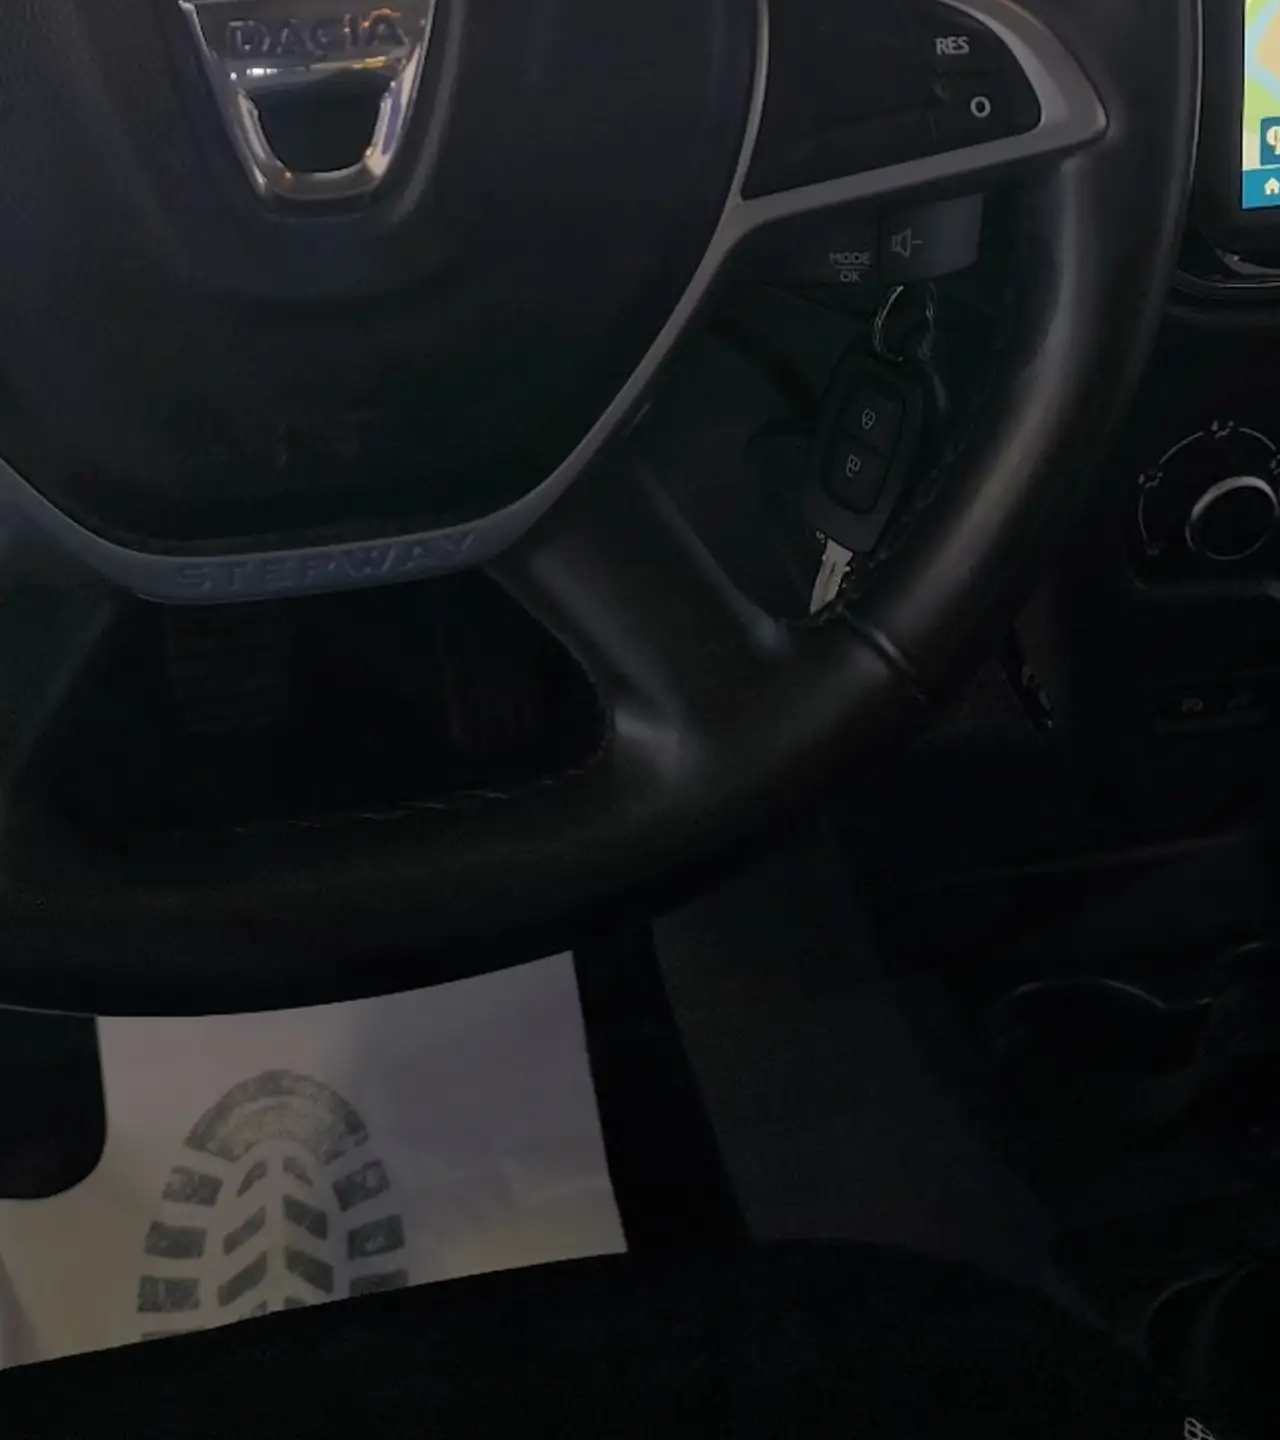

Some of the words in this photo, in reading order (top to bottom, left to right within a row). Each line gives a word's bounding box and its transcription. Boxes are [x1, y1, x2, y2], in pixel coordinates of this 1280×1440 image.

[226, 8, 410, 57] DACIA
[934, 35, 970, 56] RES
[829, 251, 871, 267] MODE
[839, 269, 863, 284] OK
[174, 531, 477, 591] STEPWAY
